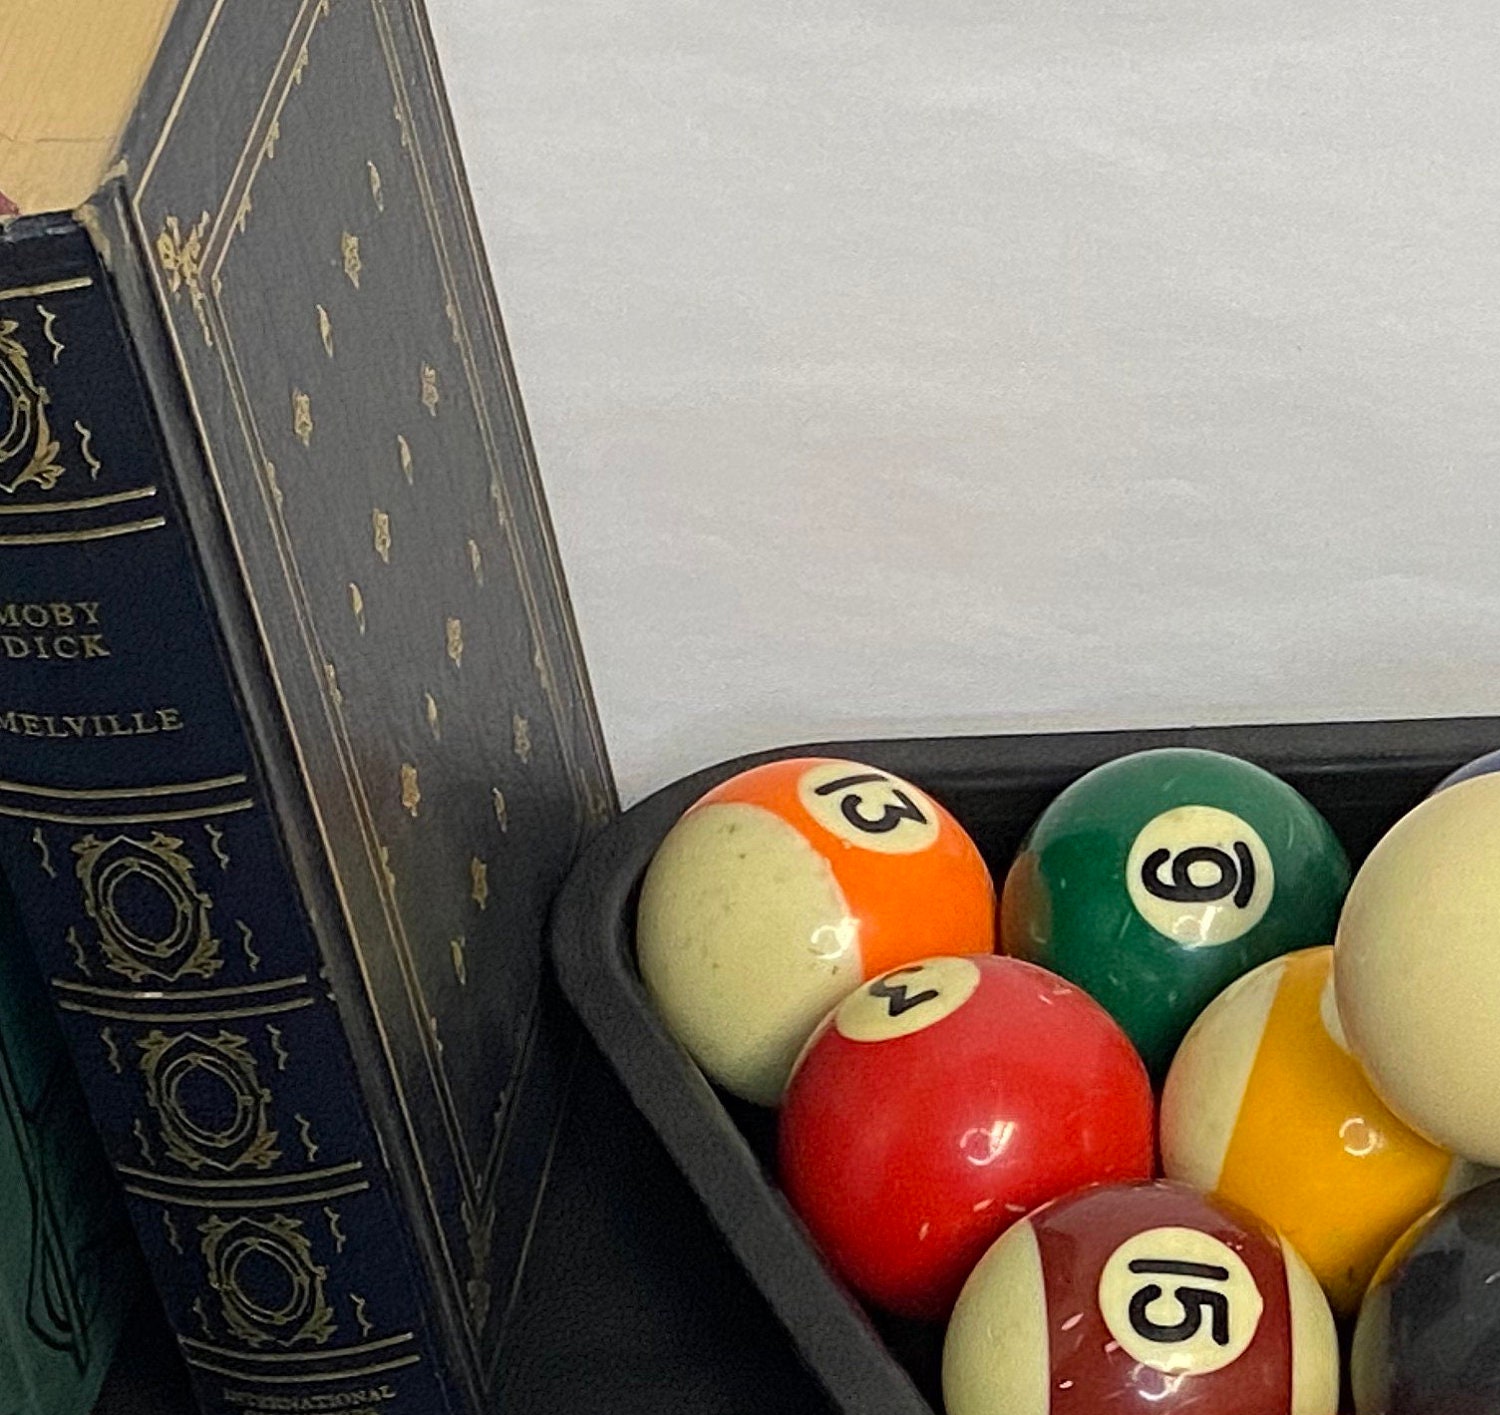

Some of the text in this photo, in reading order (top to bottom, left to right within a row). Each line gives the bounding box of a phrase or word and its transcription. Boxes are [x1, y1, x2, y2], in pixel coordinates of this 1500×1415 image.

[0, 602, 99, 627] MOBY
[1, 634, 110, 659] DICK
[0, 709, 184, 738] MELVILLE
[813, 772, 928, 834] 13
[869, 965, 939, 1017] 3
[1127, 1258, 1229, 1346] 15
